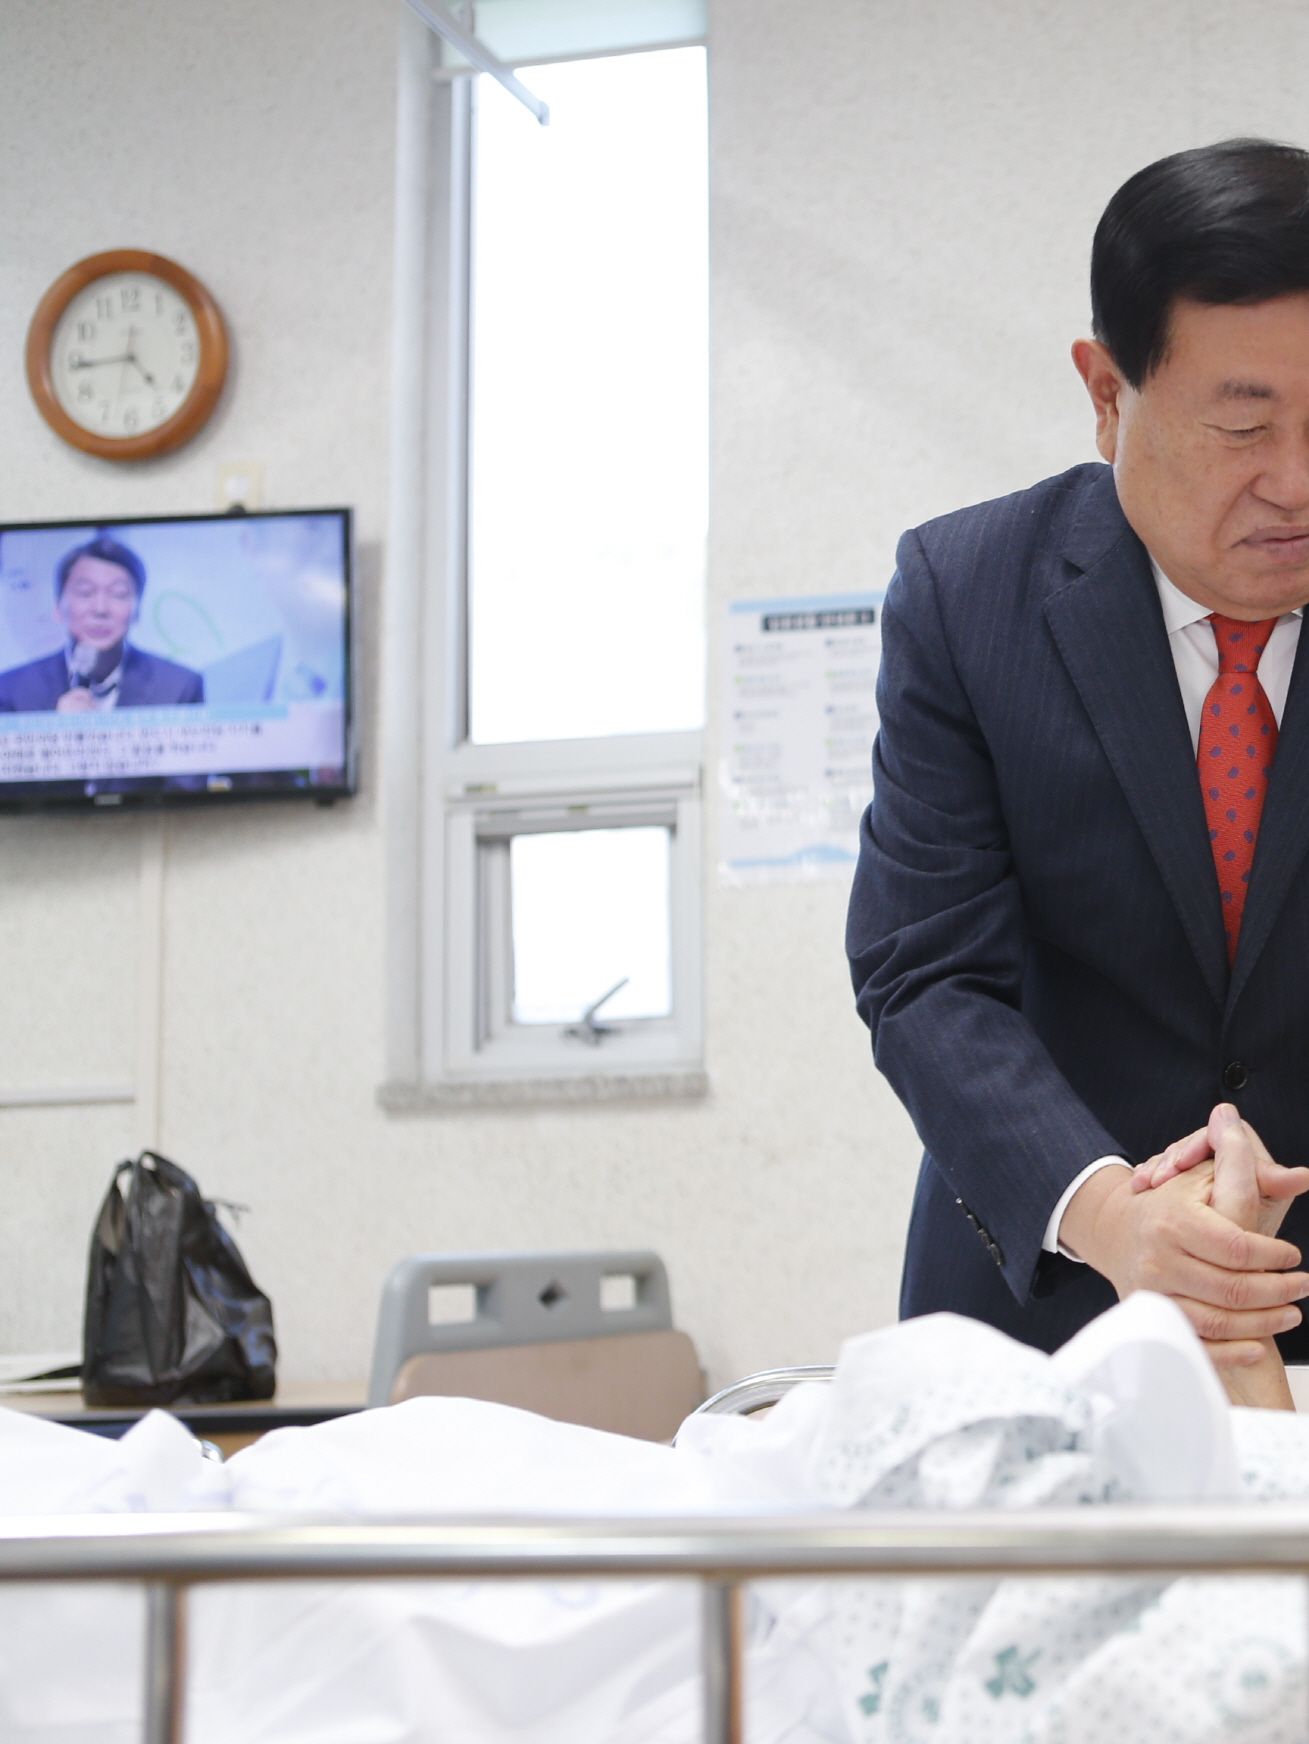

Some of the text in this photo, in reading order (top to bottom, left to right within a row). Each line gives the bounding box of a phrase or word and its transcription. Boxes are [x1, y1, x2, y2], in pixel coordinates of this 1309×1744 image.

[96, 296, 114, 320] 11
[120, 286, 140, 312] 12
[154, 293, 164, 318] 1
[77, 320, 95, 344] 10
[173, 309, 186, 337] 2
[123, 405, 138, 432] 6
